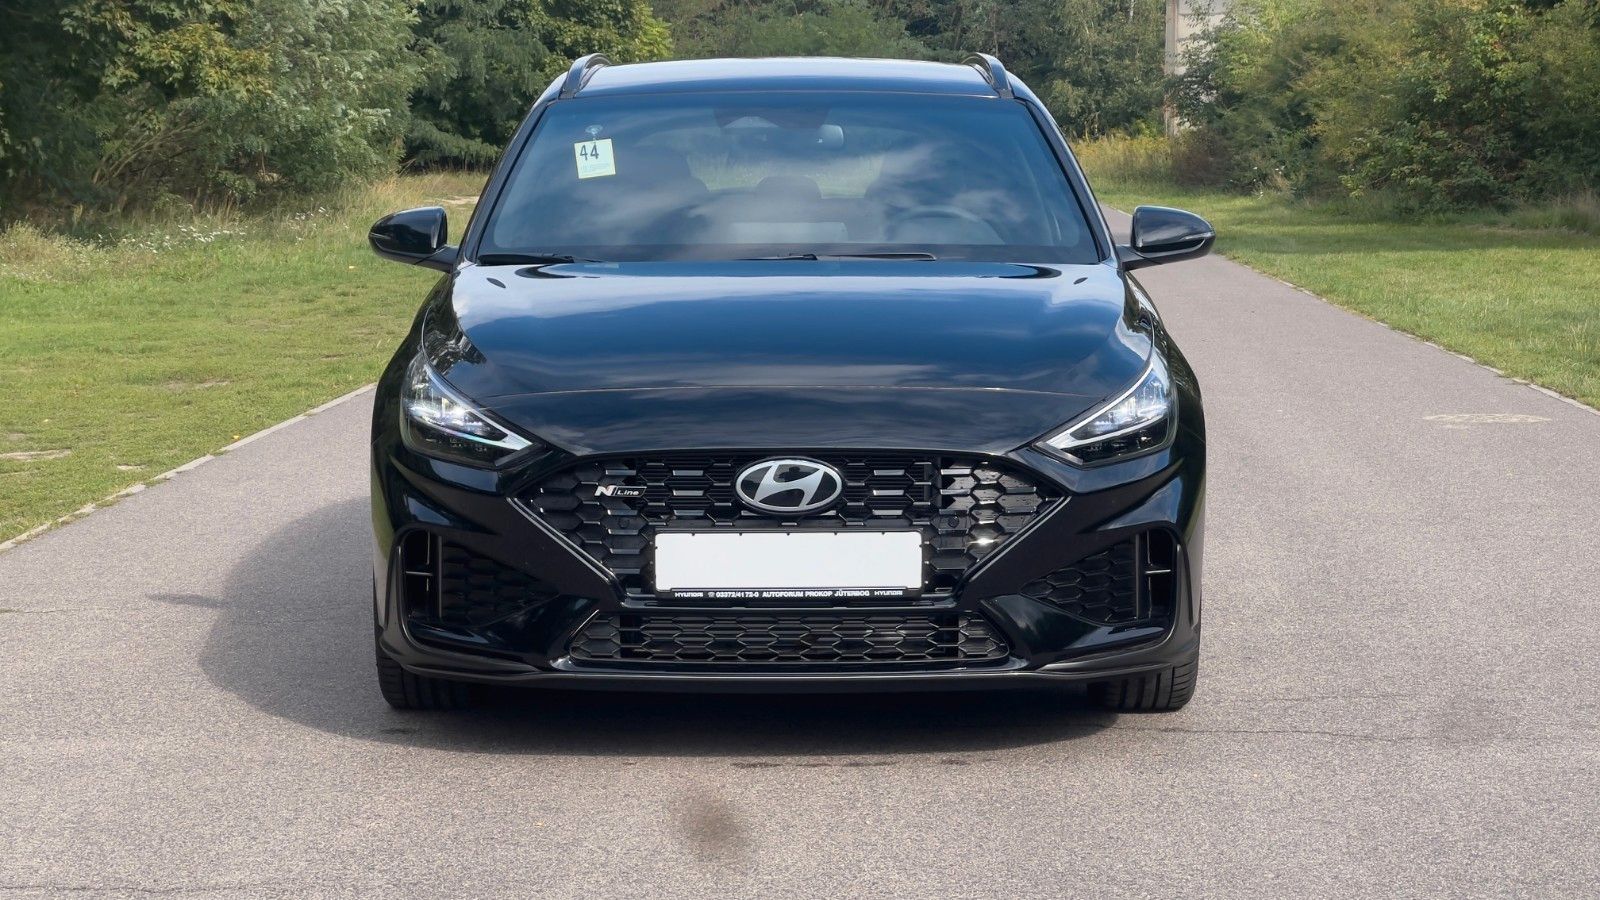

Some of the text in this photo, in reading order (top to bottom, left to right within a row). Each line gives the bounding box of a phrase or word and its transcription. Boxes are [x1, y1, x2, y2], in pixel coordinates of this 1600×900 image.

[579, 144, 600, 161] 44
[594, 485, 617, 497] N
[834, 589, 870, 597] JÜTERBOG
